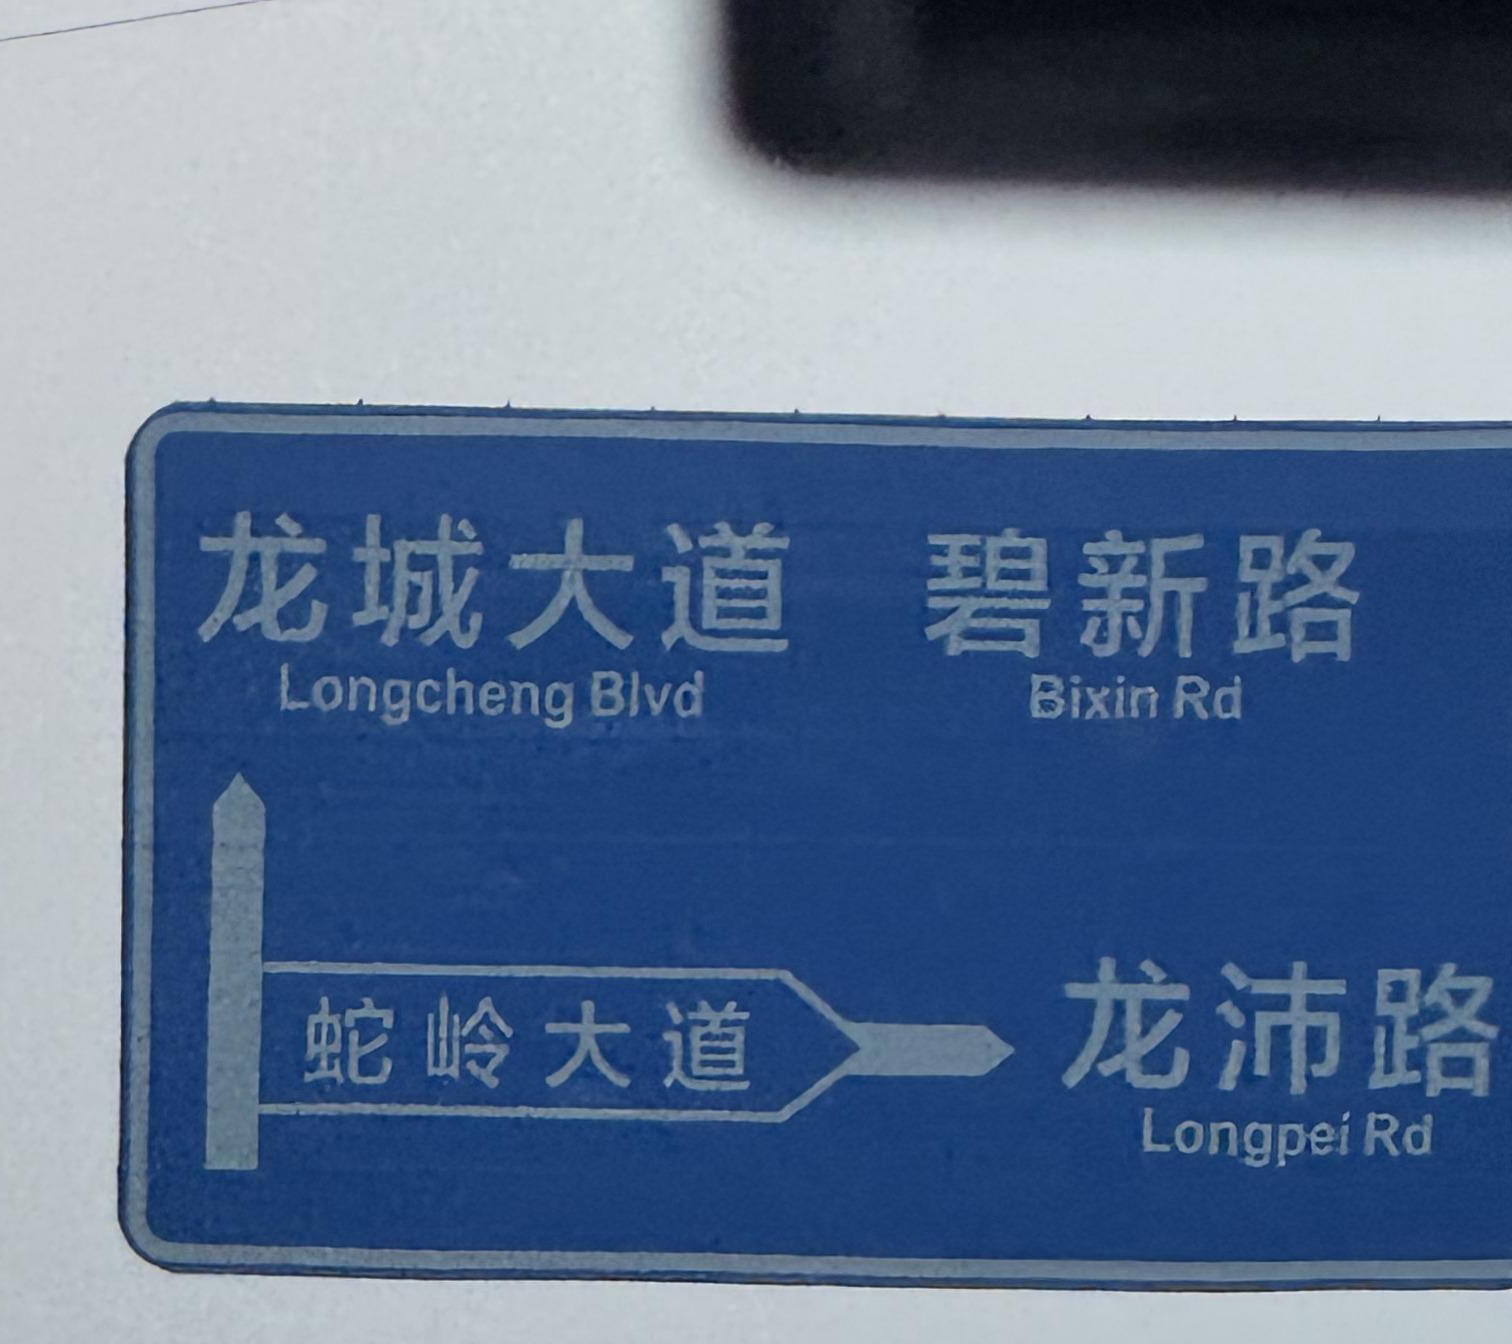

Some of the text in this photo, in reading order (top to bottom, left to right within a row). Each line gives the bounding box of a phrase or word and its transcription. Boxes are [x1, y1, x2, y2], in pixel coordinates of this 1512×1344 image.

[199, 510, 791, 653] 龙城大道
[924, 527, 1360, 663] 碧新路
[280, 663, 705, 729] Longcheng Blvd
[1030, 673, 1242, 720] Bixin Rd
[304, 995, 750, 1091] 蛇岭大道
[1063, 956, 1498, 1097] 龙沛路
[1142, 1107, 1434, 1167] Longpei Rd
